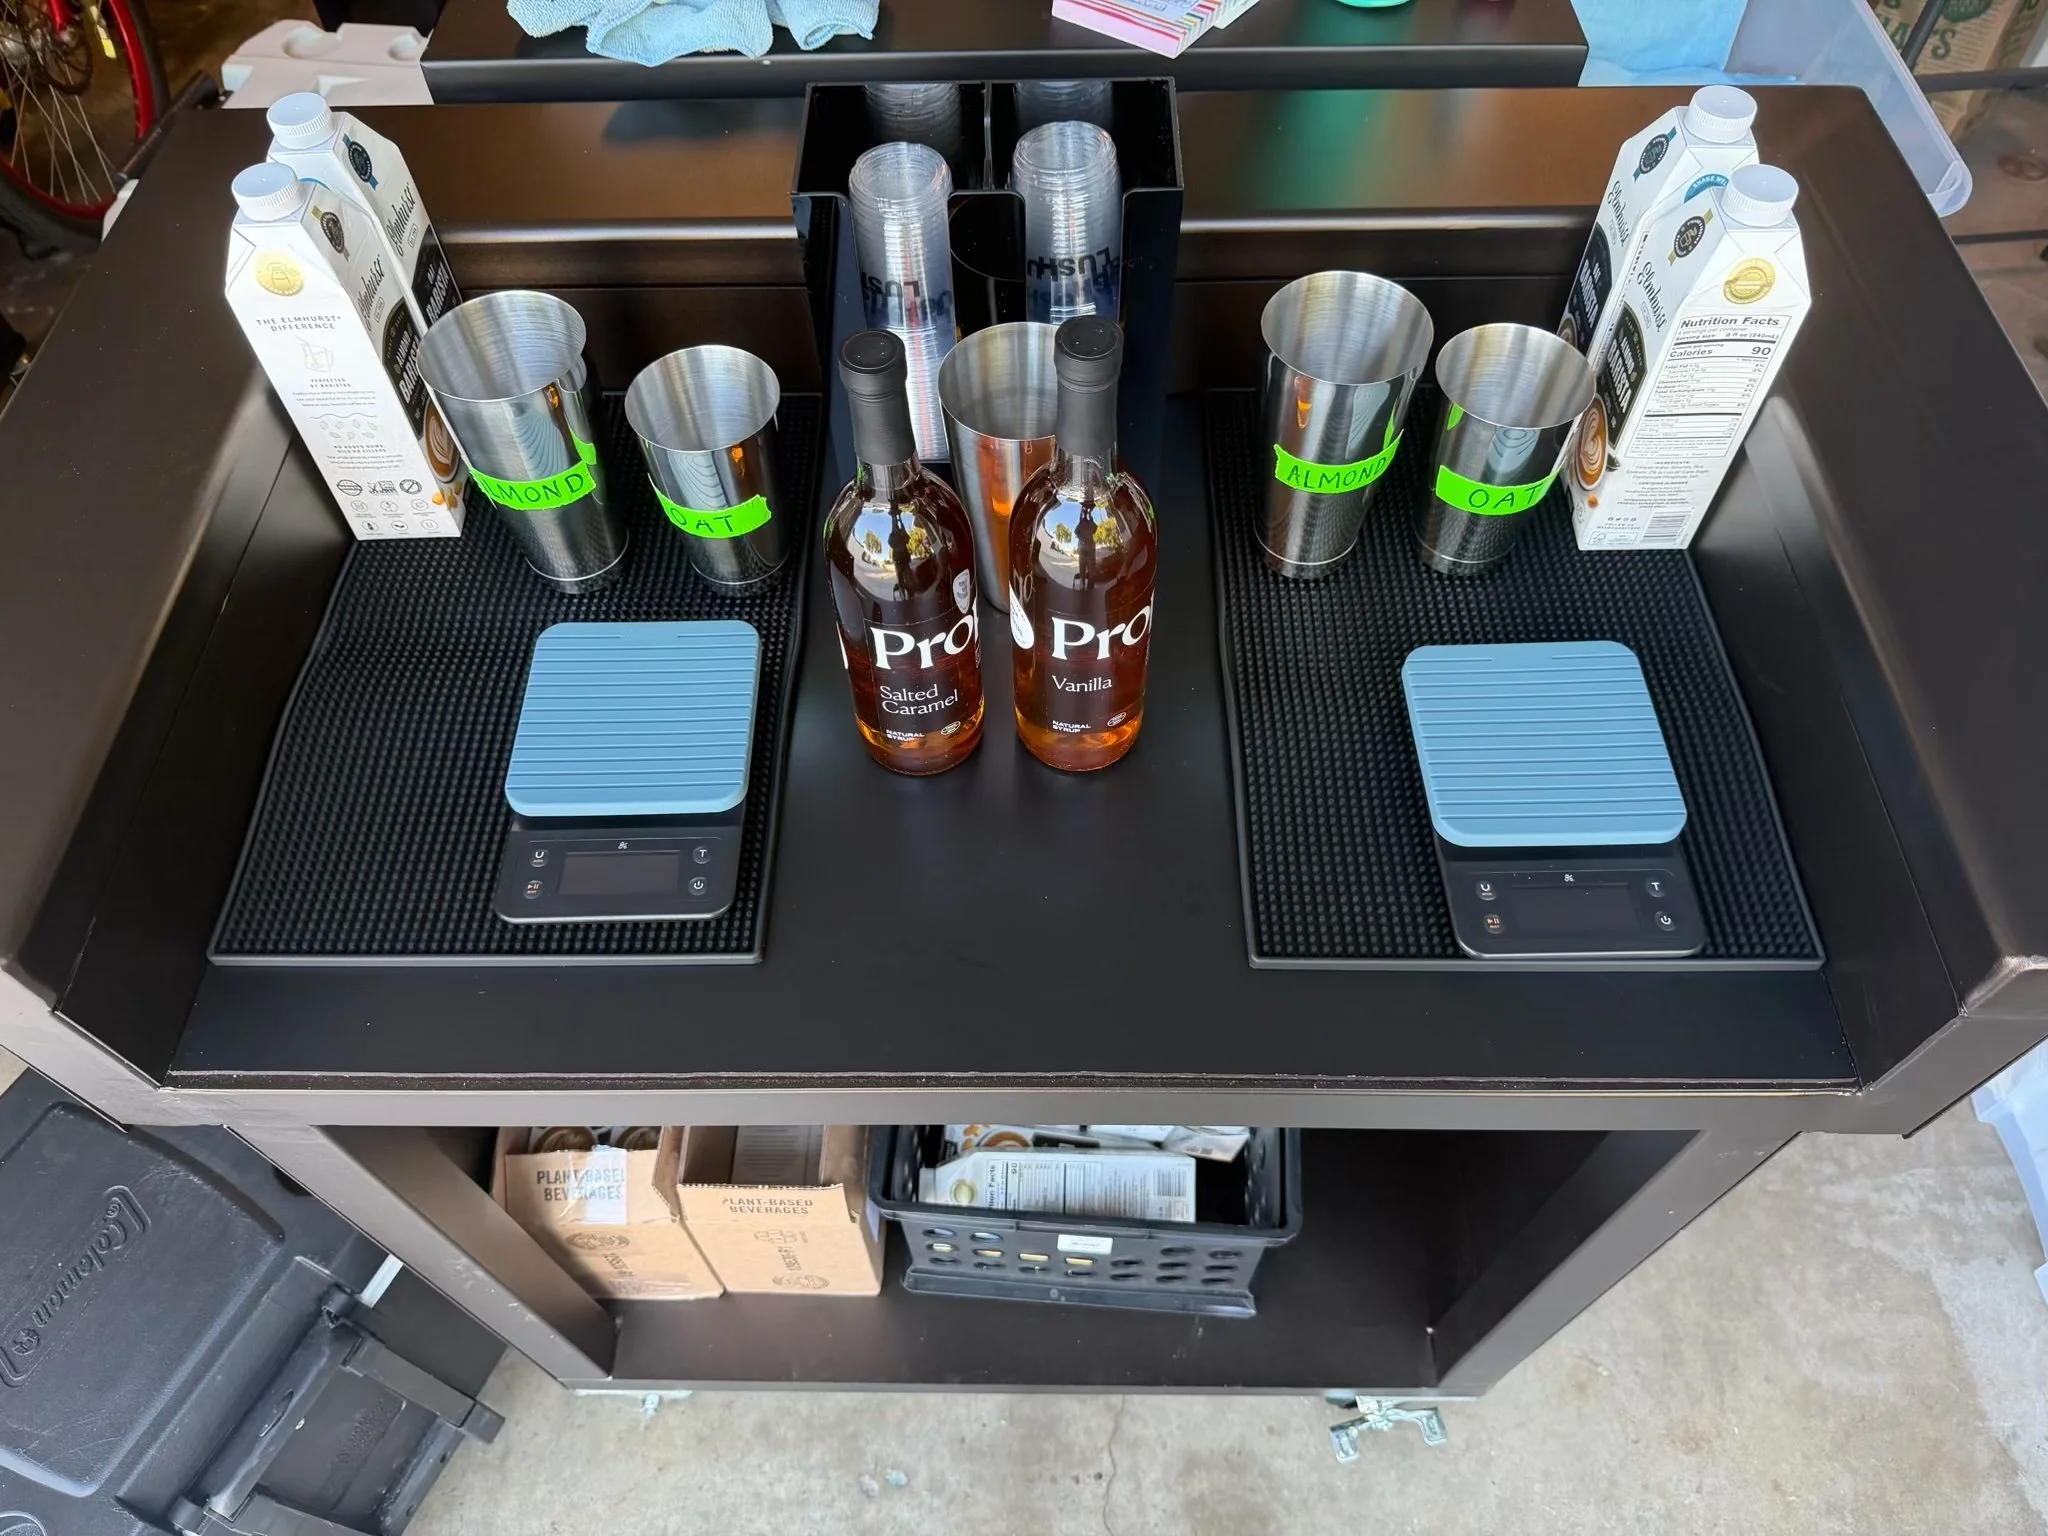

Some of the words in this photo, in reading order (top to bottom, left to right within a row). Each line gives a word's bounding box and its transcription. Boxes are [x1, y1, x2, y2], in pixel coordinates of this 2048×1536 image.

[1579, 258, 1599, 329] BARISTA
[256, 317, 278, 326] THE
[270, 322, 336, 332] DIFFERENCE
[1680, 316, 1738, 329] Nutrition
[1741, 316, 1780, 326] Facts
[396, 330, 411, 367] ALMOND
[1620, 336, 1635, 375] ALMOND
[1669, 348, 1714, 358] Calories
[1750, 346, 1772, 356] 90
[1607, 338, 1632, 414] BARISTA
[1286, 456, 1388, 490] ALMOND
[1468, 483, 1545, 509] OAT
[669, 507, 734, 533] OAT
[1051, 588, 1155, 661] Pro
[879, 683, 939, 703] Salted
[1051, 674, 1113, 694] Vanilla
[881, 689, 959, 716] Caramel
[885, 728, 926, 738] NATURAL
[1052, 720, 1092, 729] NATURAL
[1052, 724, 1081, 733] SYRUP
[1010, 1162, 1018, 1175] 90
[722, 1198, 813, 1207] PLANT-BASED
[729, 1206, 810, 1215] BEVERAGES
[31, 1219, 128, 1328] Coleman
